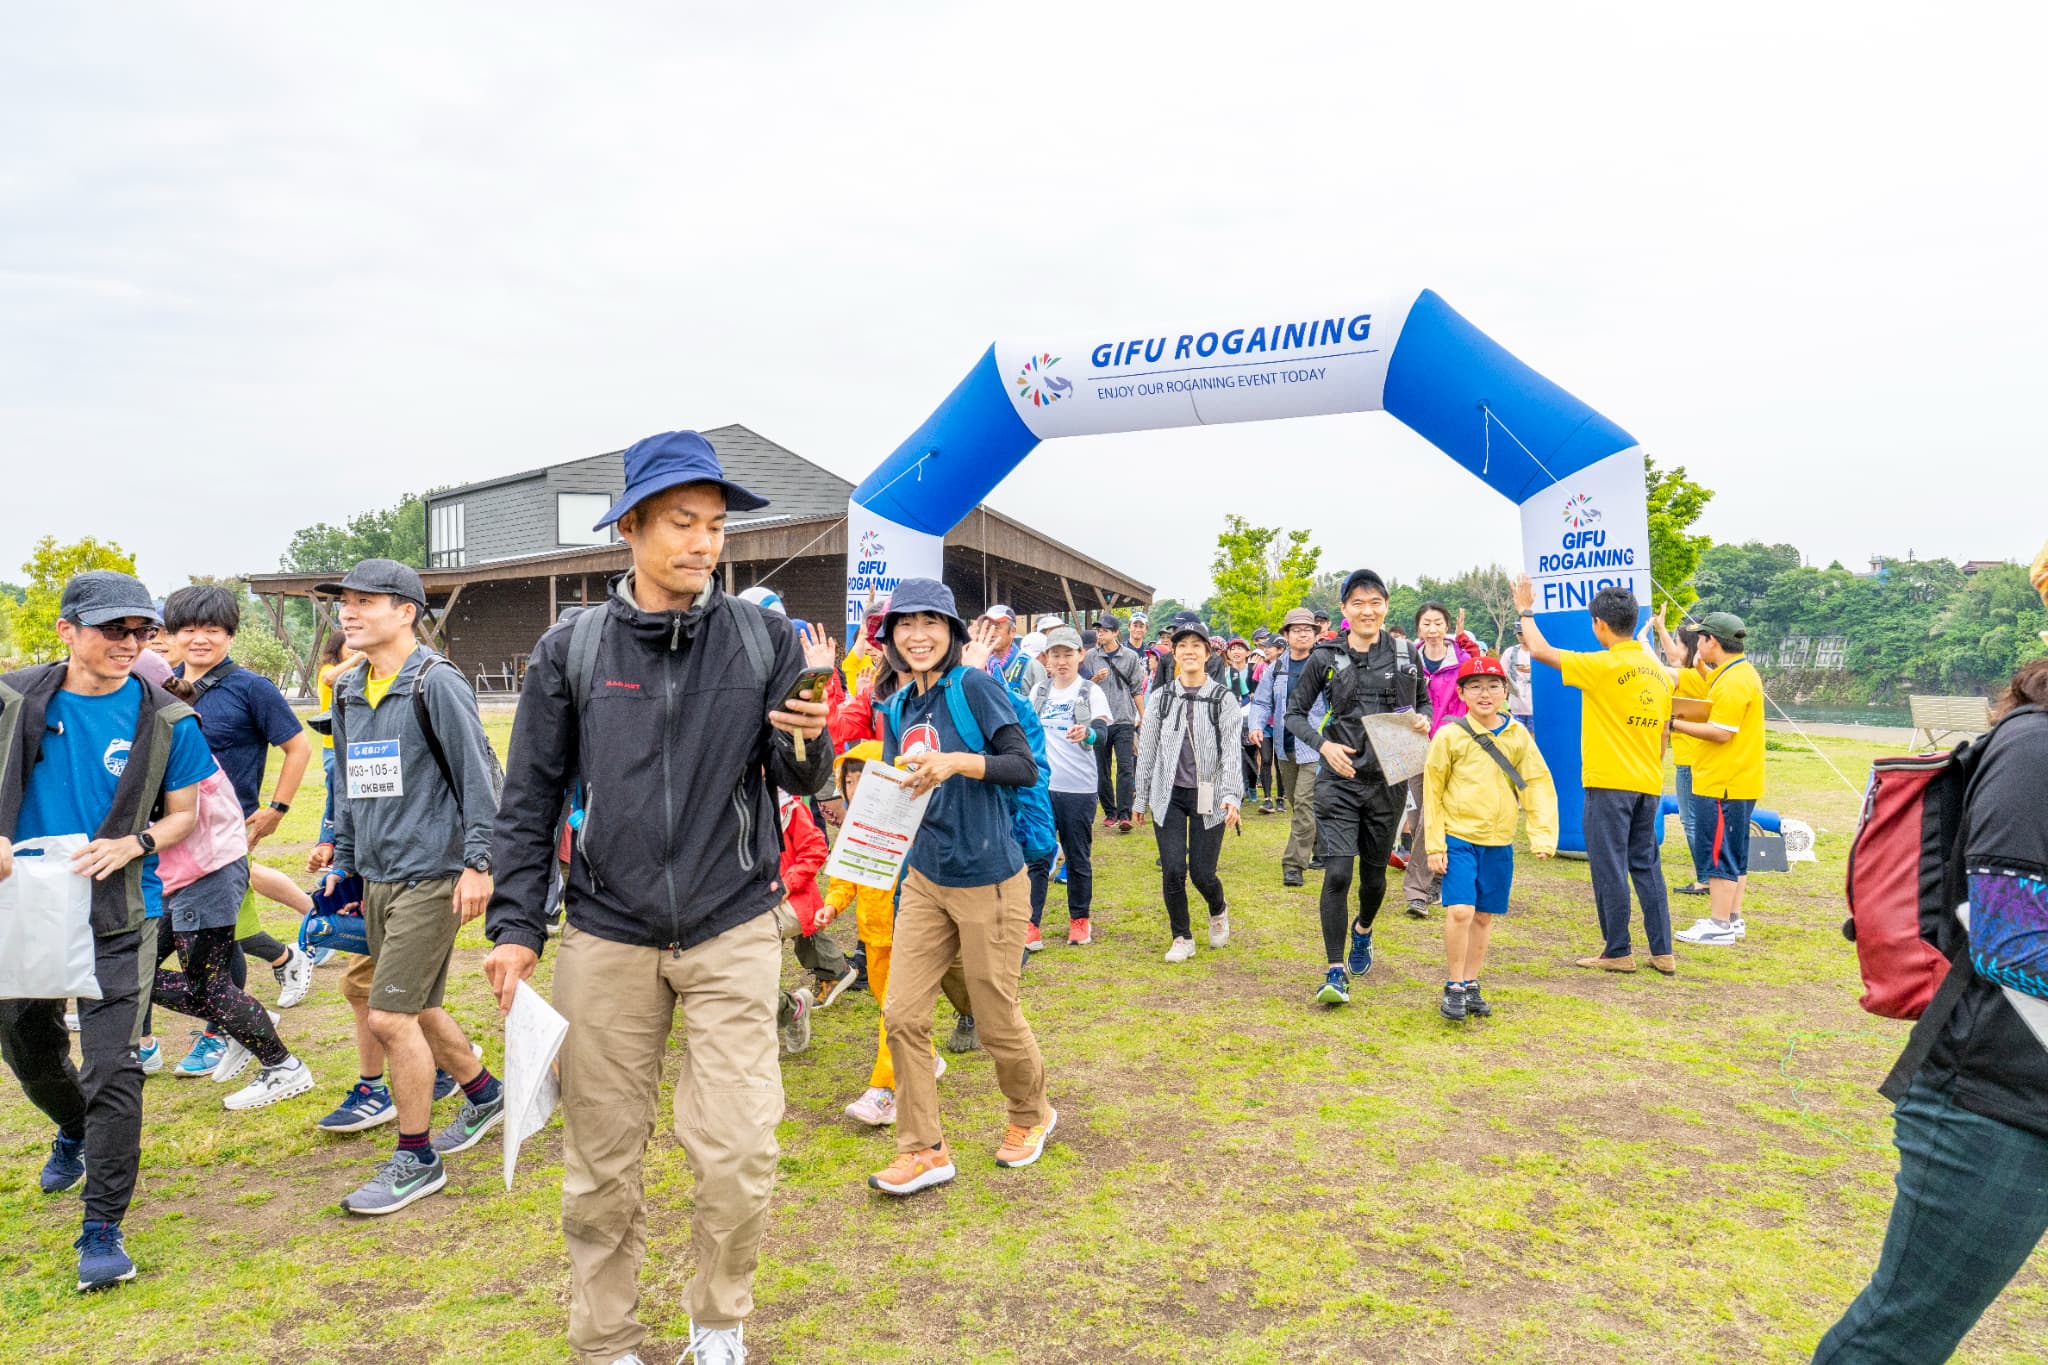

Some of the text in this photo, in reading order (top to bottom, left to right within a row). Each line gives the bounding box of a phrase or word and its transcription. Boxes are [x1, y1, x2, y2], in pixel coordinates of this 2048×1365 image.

[1091, 314, 1372, 368] GIFU ROGAINING
[1097, 367, 1327, 400] ENJOY OUR ROGAINING EVENT TODAY
[1562, 529, 1606, 550] GIFU
[858, 560, 887, 575] GIFU
[1539, 548, 1634, 572] ROGAINING
[1617, 668, 1636, 685] GIFU
[1627, 715, 1659, 728] STAFF
